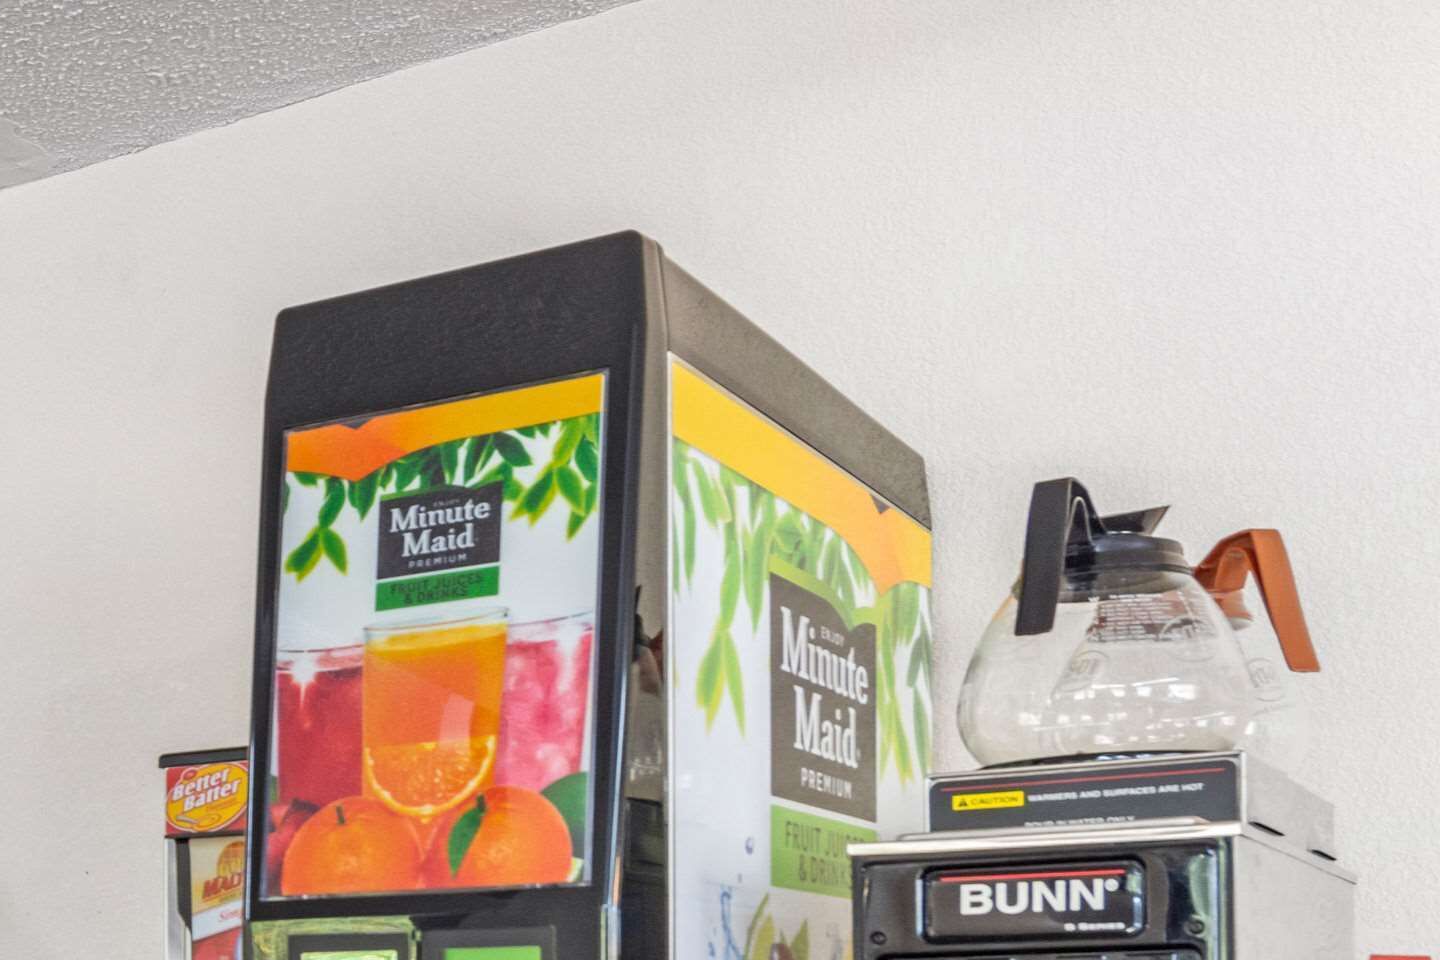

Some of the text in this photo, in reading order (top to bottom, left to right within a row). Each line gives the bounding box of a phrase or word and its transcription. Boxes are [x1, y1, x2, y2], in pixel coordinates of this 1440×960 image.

[389, 498, 491, 533] Minute
[401, 523, 475, 557] Maid
[408, 553, 467, 569] PREMIUM
[779, 605, 870, 705] Minute
[793, 684, 859, 769] Maid
[172, 768, 230, 801] Better
[183, 779, 242, 812] Batter
[800, 767, 853, 800] PREMIUM
[1027, 791, 1078, 802] WARMERS
[1079, 789, 1101, 800] AND
[1103, 785, 1156, 798] SURFACES
[1157, 784, 1179, 793] ARE
[1180, 782, 1205, 791] HOT
[784, 820, 821, 854] FRUIT
